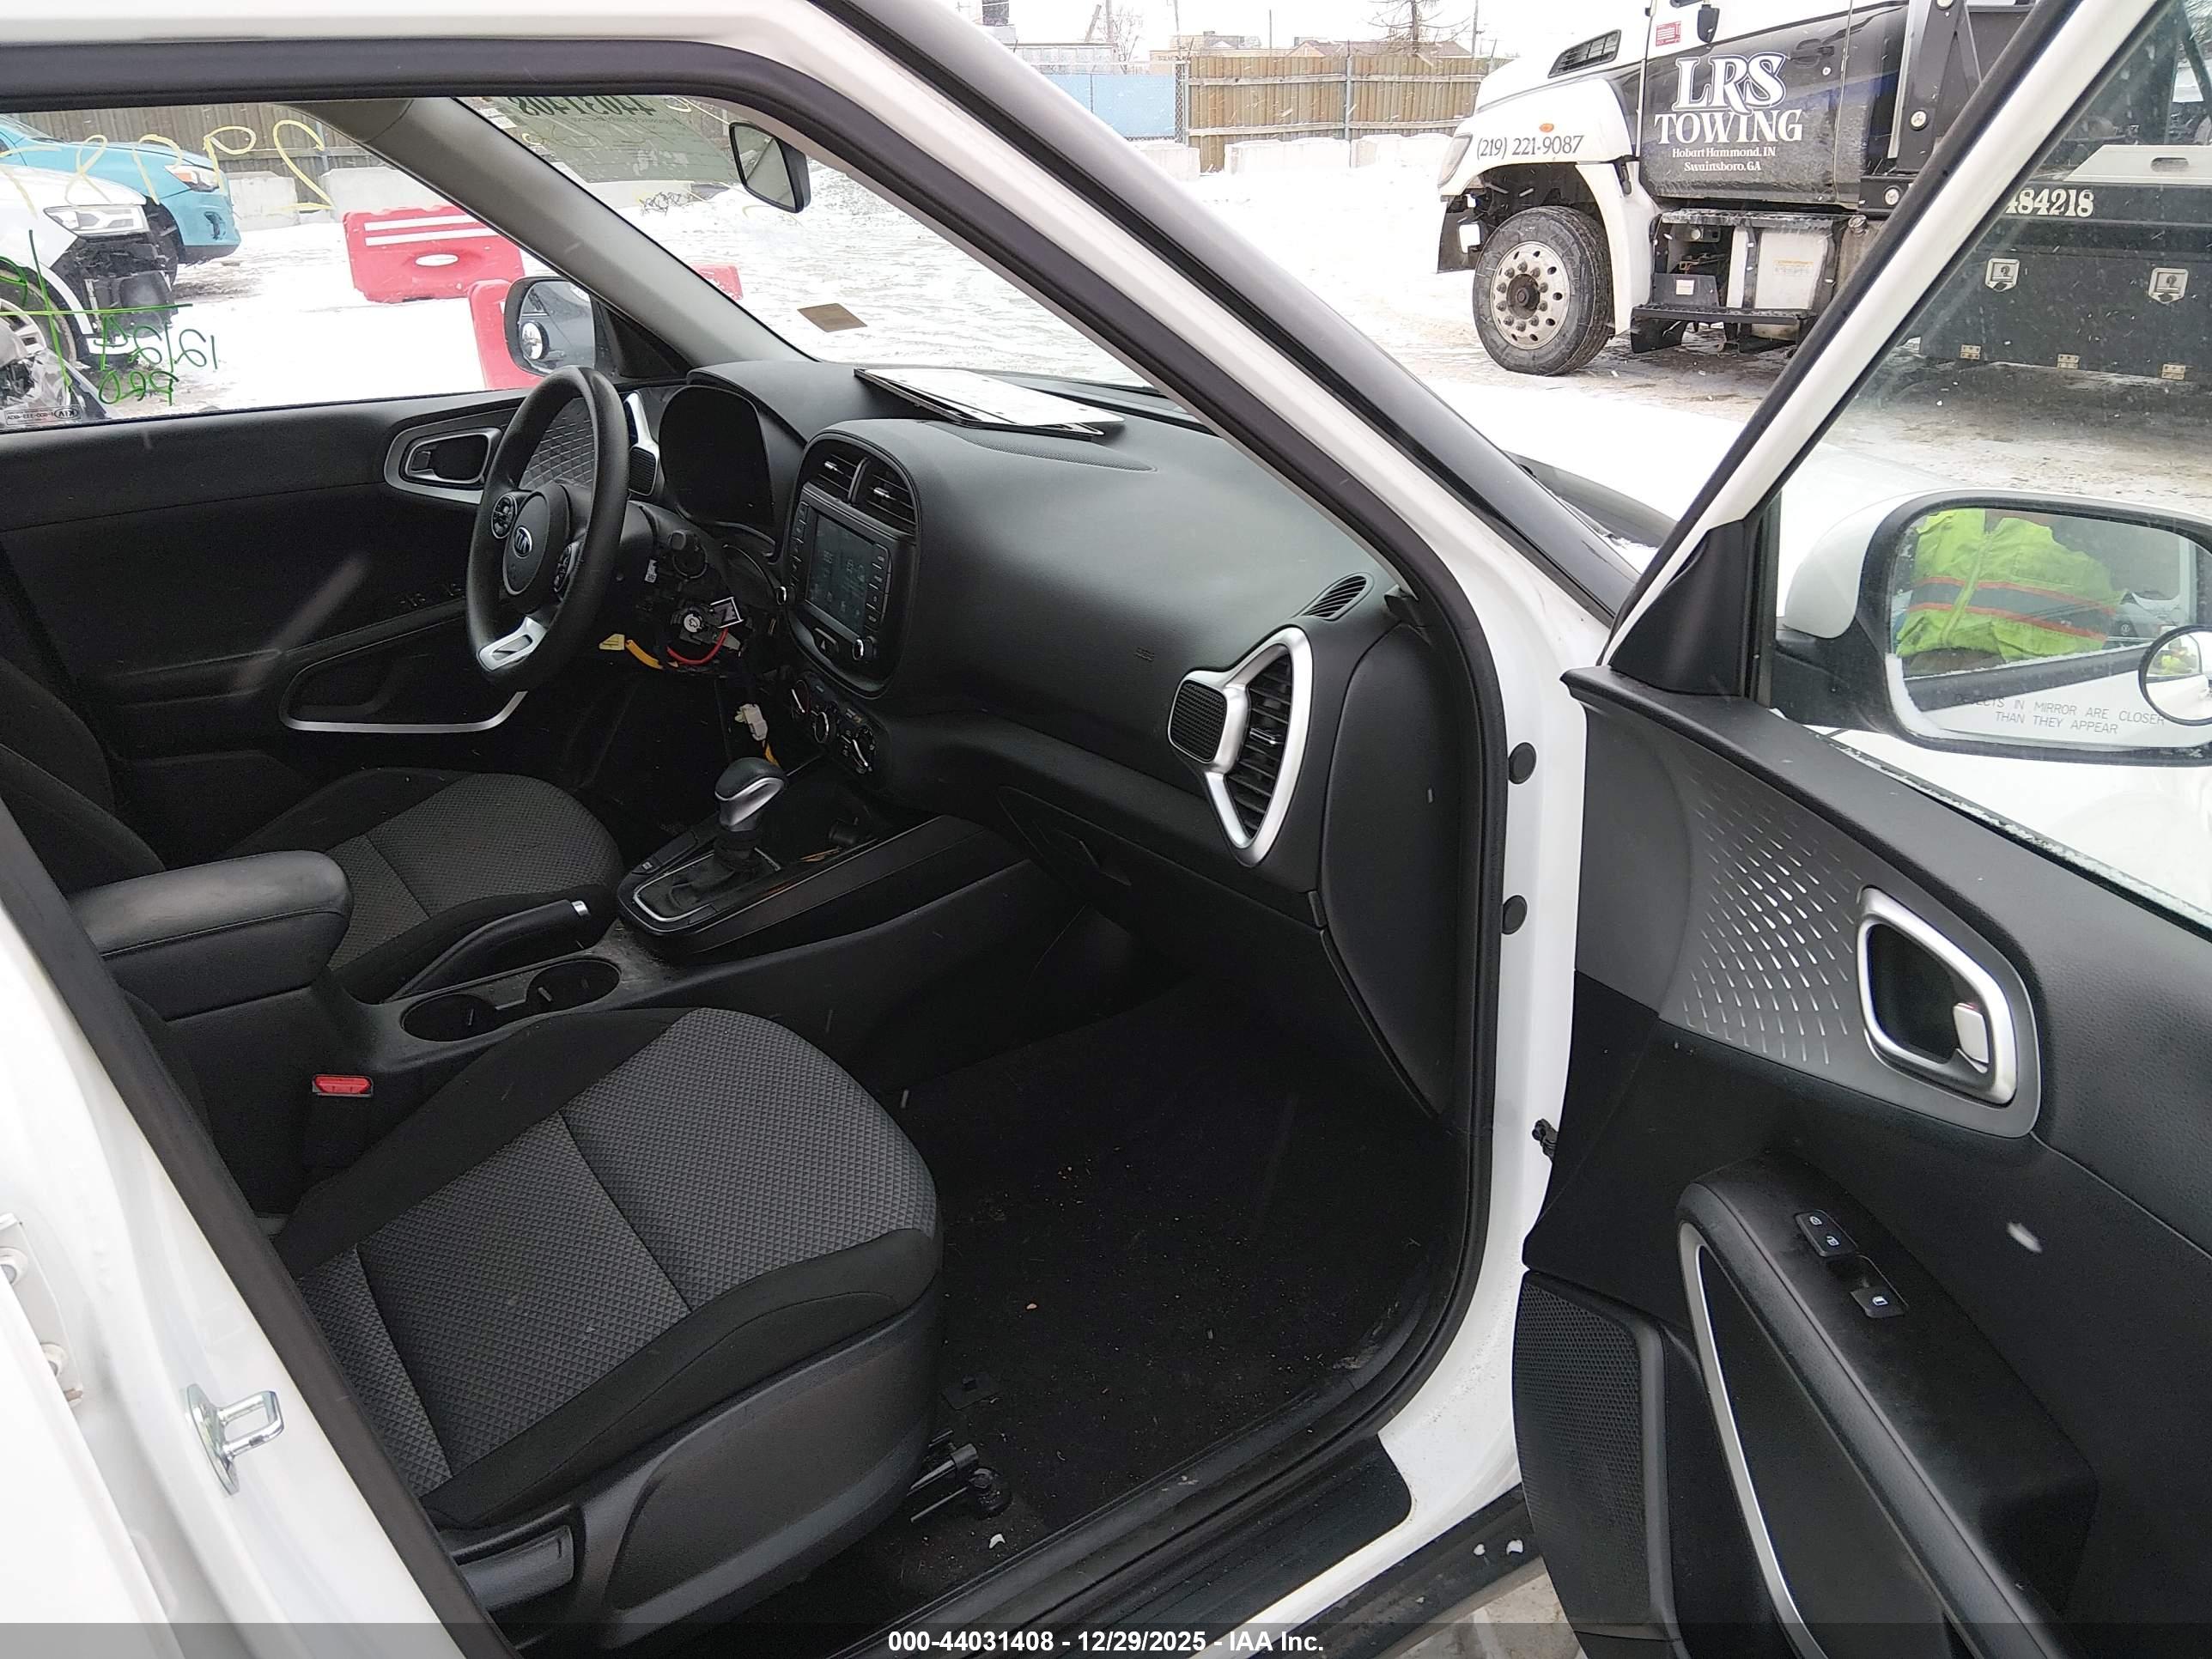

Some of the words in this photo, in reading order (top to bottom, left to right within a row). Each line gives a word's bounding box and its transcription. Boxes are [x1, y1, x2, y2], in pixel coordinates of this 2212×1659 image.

[1672, 52, 1786, 117] LRS
[1654, 109, 1803, 145] TOWING
[1477, 137, 1507, 161] (219)
[1511, 135, 1584, 155] 221-9087
[1672, 148, 1705, 158] Hobart
[2014, 699, 2026, 709] IN
[2033, 702, 2077, 715] MIRROR
[2085, 707, 2110, 720] ARE
[1995, 711, 2026, 723] THAN
[2033, 714, 2064, 728] THEY
[2069, 720, 2118, 733] APPEAR
